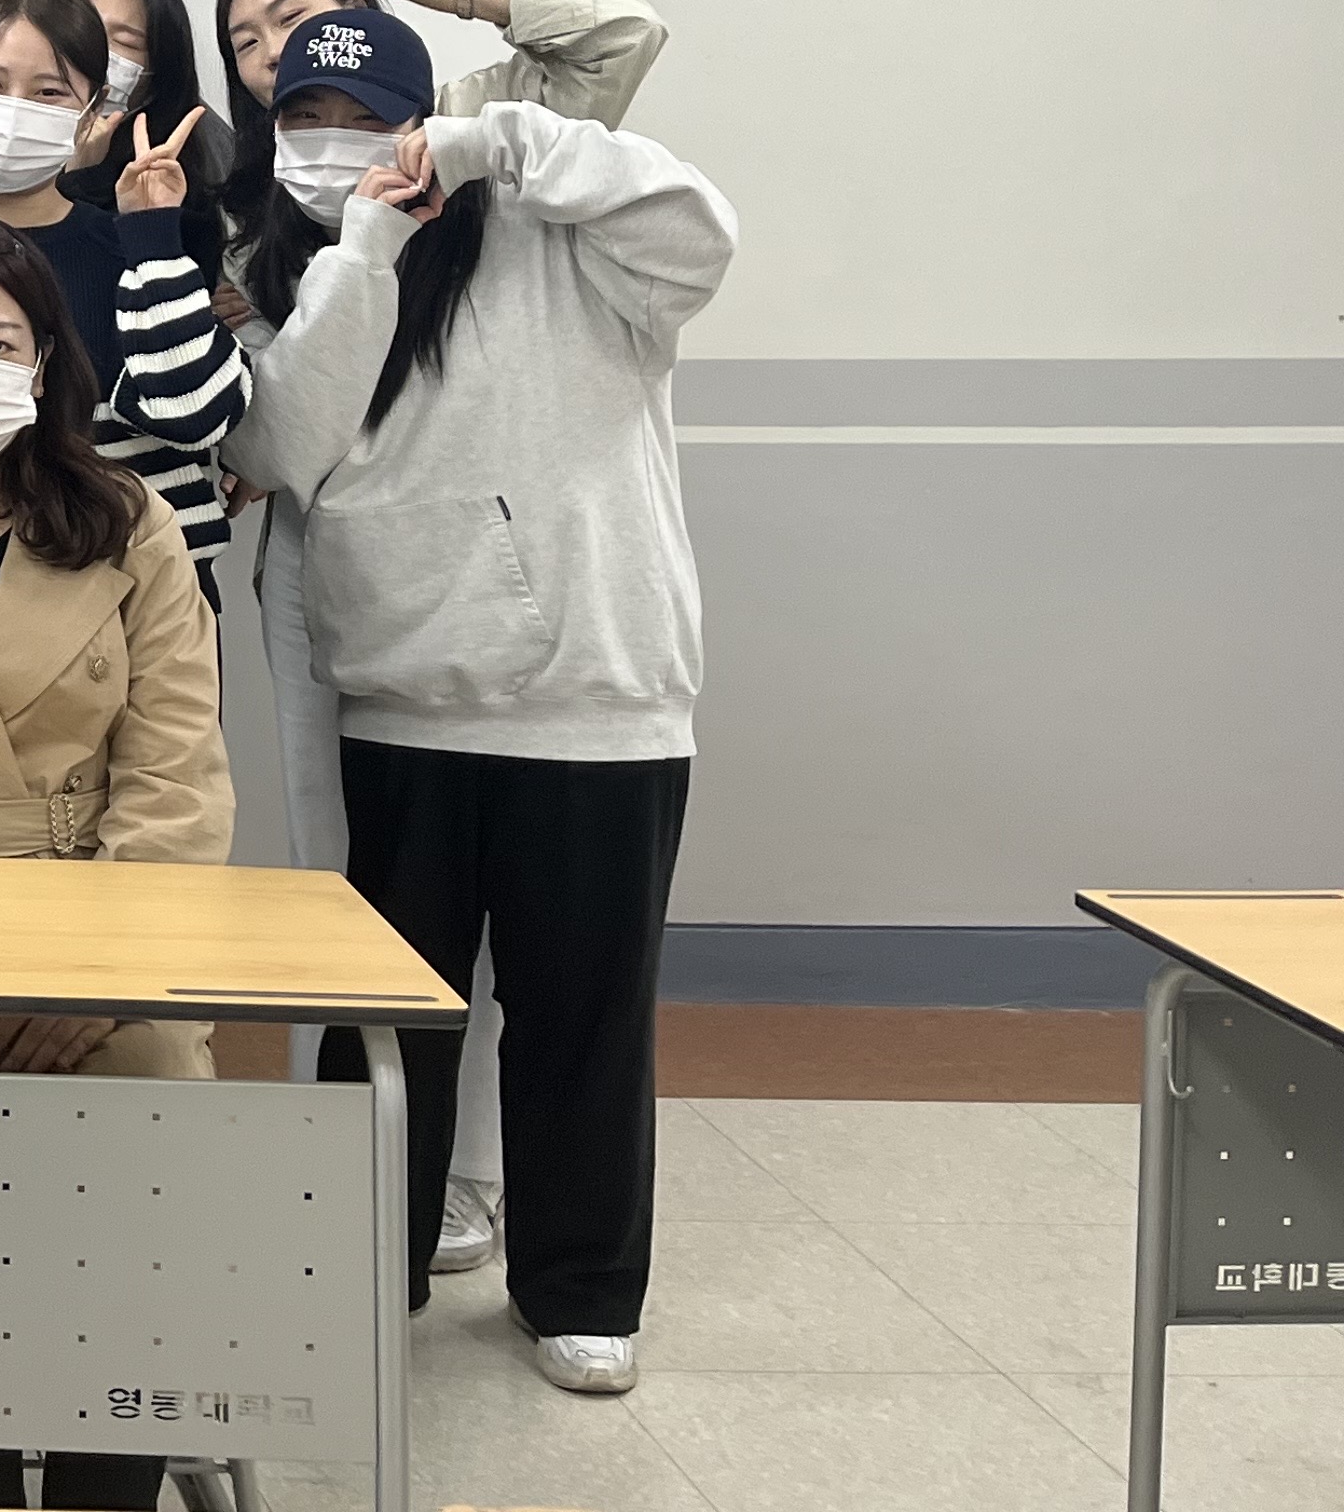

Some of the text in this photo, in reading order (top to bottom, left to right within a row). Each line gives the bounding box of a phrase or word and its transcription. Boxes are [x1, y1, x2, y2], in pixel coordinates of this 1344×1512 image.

[321, 24, 367, 40] Type
[307, 39, 373, 57] Service
[313, 51, 361, 70] .Web
